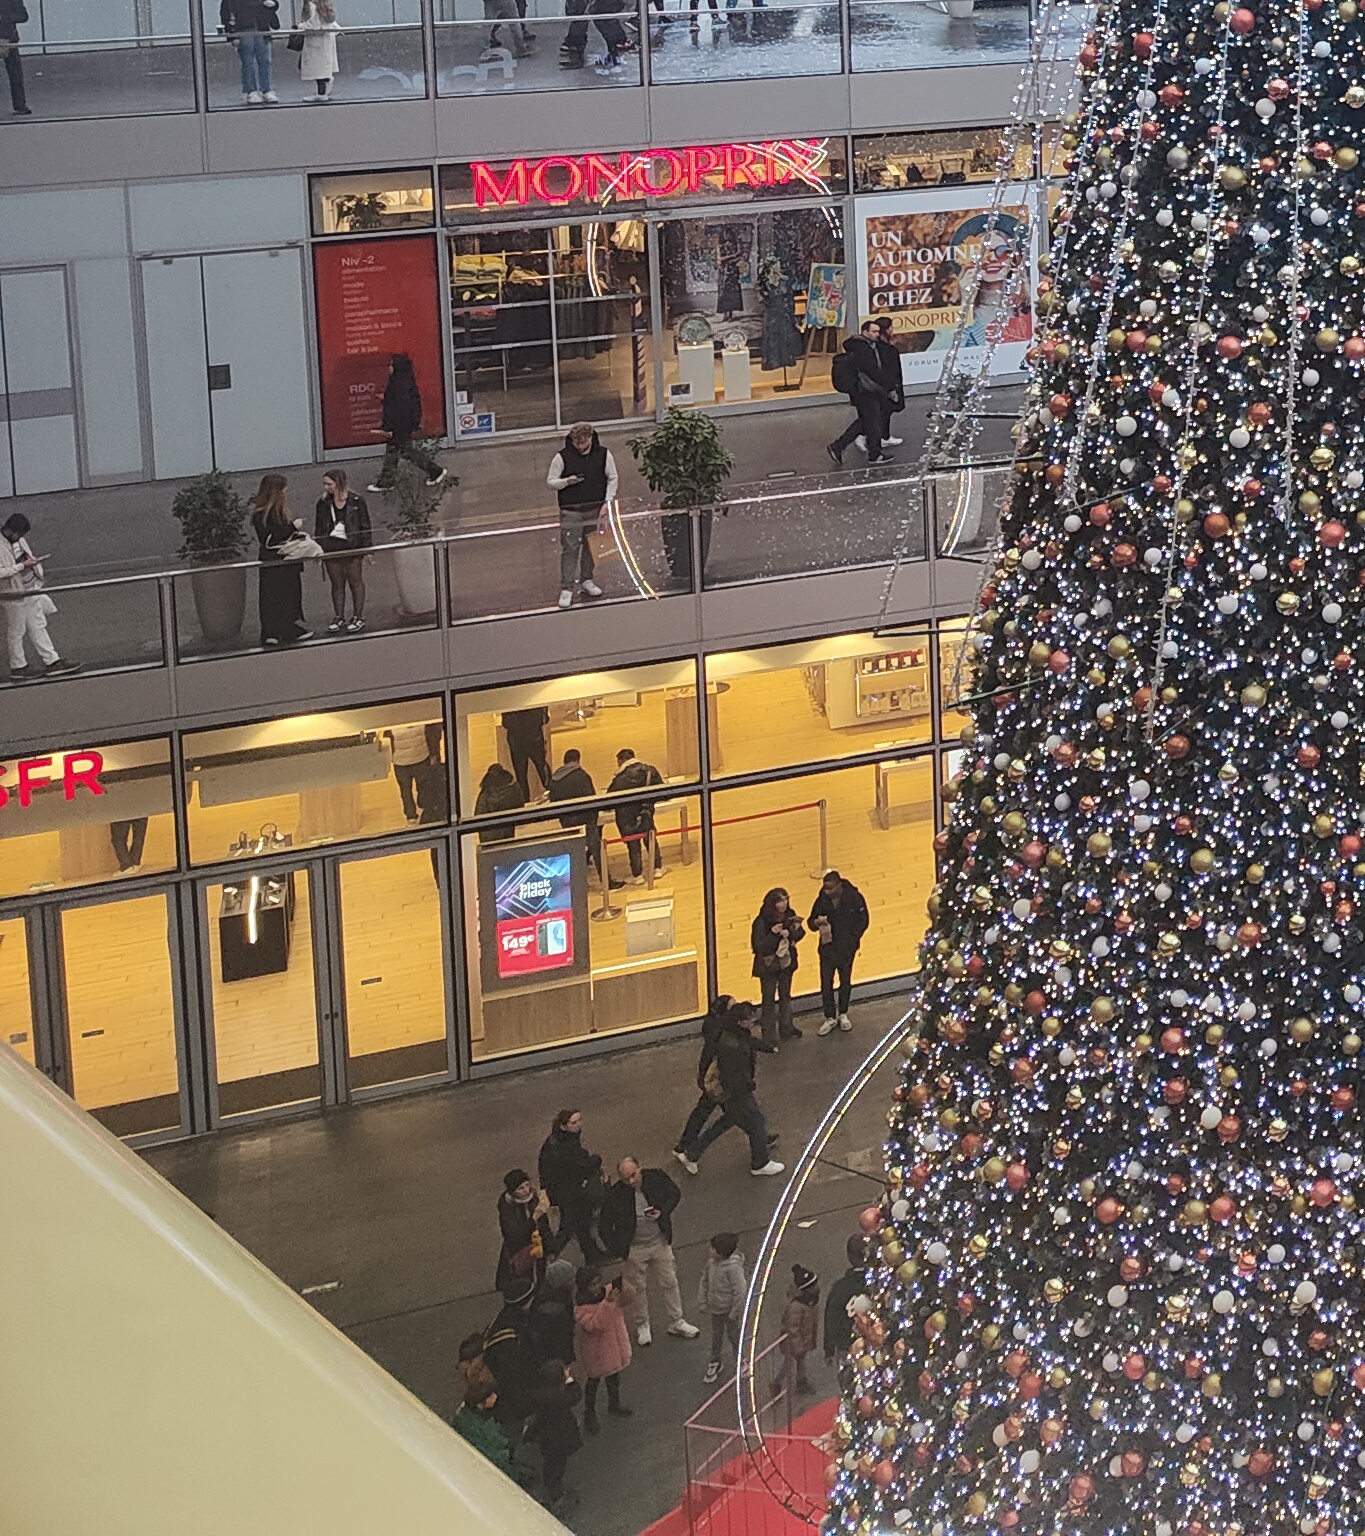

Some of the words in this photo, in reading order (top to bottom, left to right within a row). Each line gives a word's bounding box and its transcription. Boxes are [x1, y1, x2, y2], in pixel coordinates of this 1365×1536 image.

[470, 139, 822, 209] MONOPRIX
[870, 230, 902, 248] UN
[341, 257, 360, 266] Niv
[362, 255, 375, 264] -2
[871, 244, 982, 268] AUTOMNE
[872, 264, 935, 288] DORÉ
[872, 287, 933, 308] CHEZ
[891, 311, 963, 331] ONOPRI
[0, 750, 105, 810] FR
[519, 887, 552, 900] friday
[520, 879, 551, 892] black
